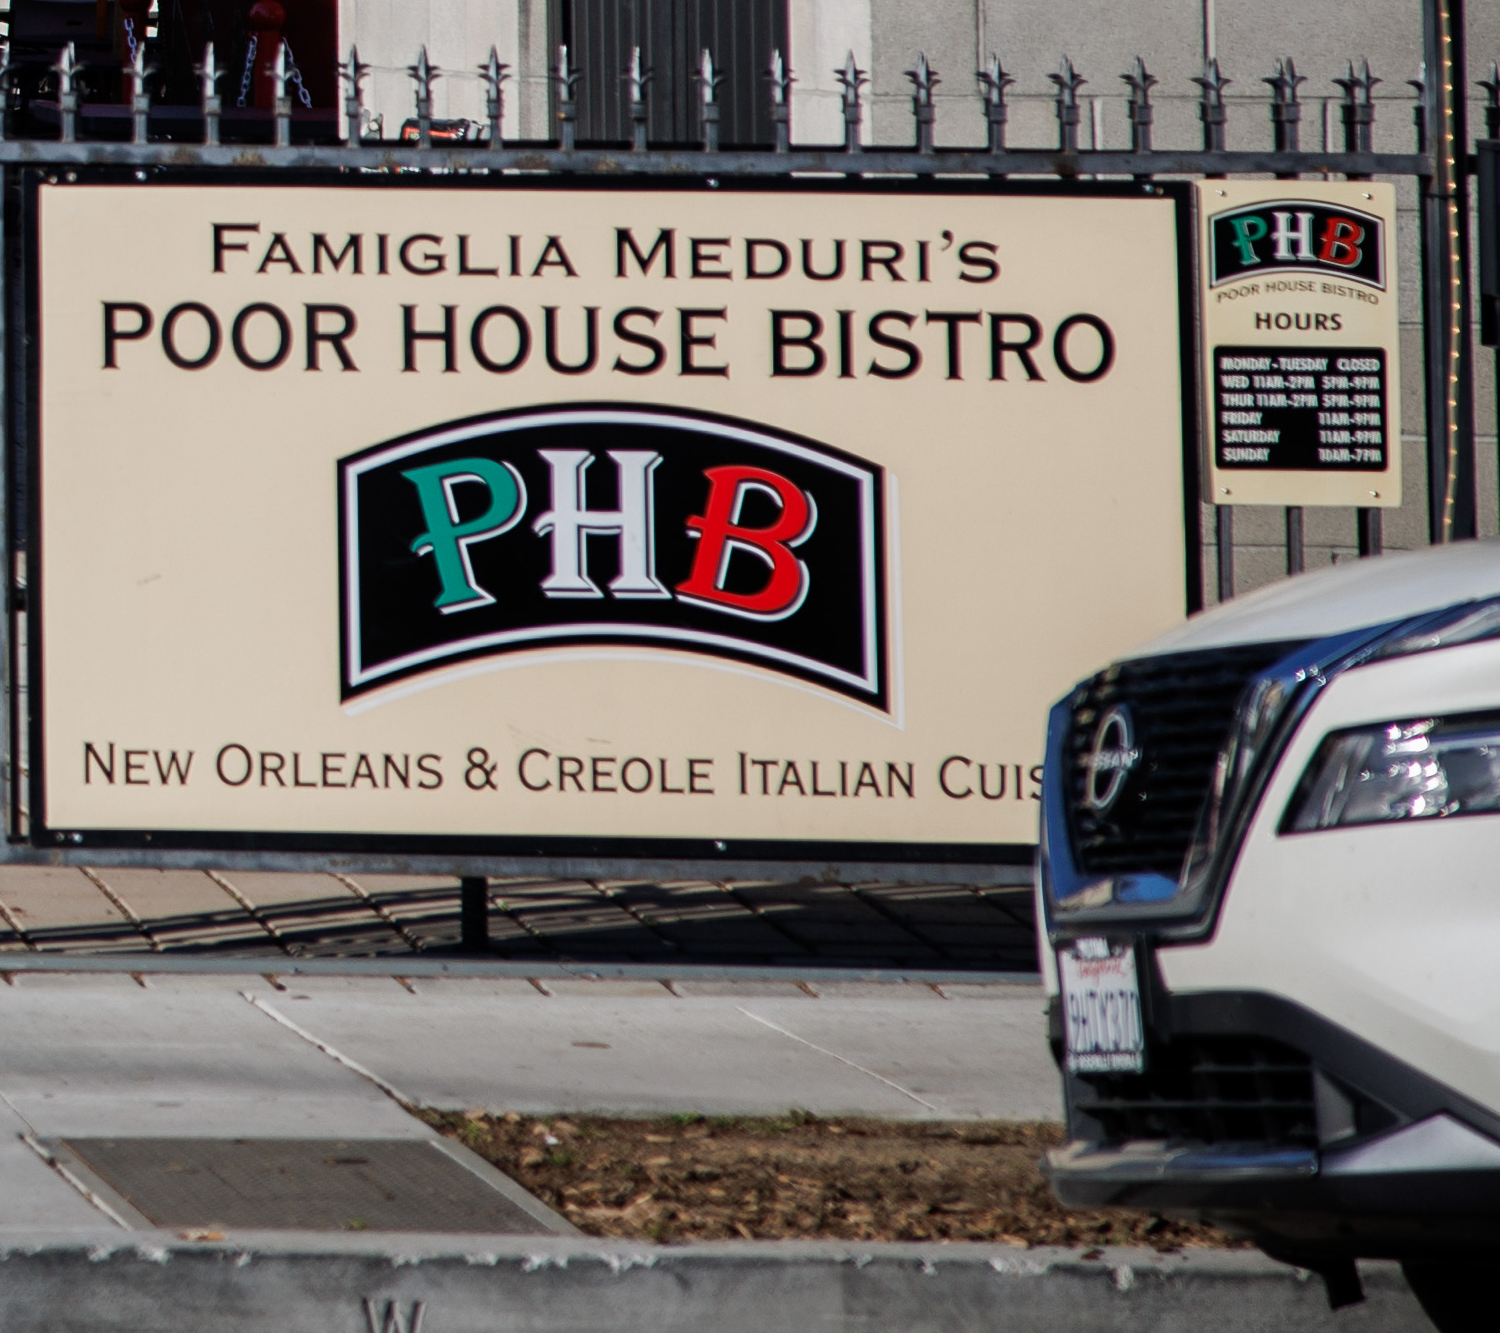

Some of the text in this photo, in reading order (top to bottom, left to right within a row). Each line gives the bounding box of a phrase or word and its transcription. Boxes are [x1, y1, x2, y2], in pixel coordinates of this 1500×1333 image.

[1230, 212, 1365, 268] PHB
[209, 221, 1002, 284] FAMIGLIA MEDURI'S
[1217, 281, 1379, 305] POOR HOUSE BISTRO
[1255, 312, 1343, 331] HOURS
[100, 300, 1117, 384] POOR HOUSE BISTRO
[1336, 358, 1381, 372] CLOSED
[1220, 375, 1250, 389] WED
[1221, 393, 1255, 407] THUR
[1221, 411, 1263, 425] FRIDAY
[1222, 429, 1280, 443] SATURDAY
[1222, 447, 1270, 462] SUNDAY
[401, 449, 818, 621] PHB
[83, 741, 1045, 800] NEW ORLEANS & CREOLE ITALIAN CUIS
